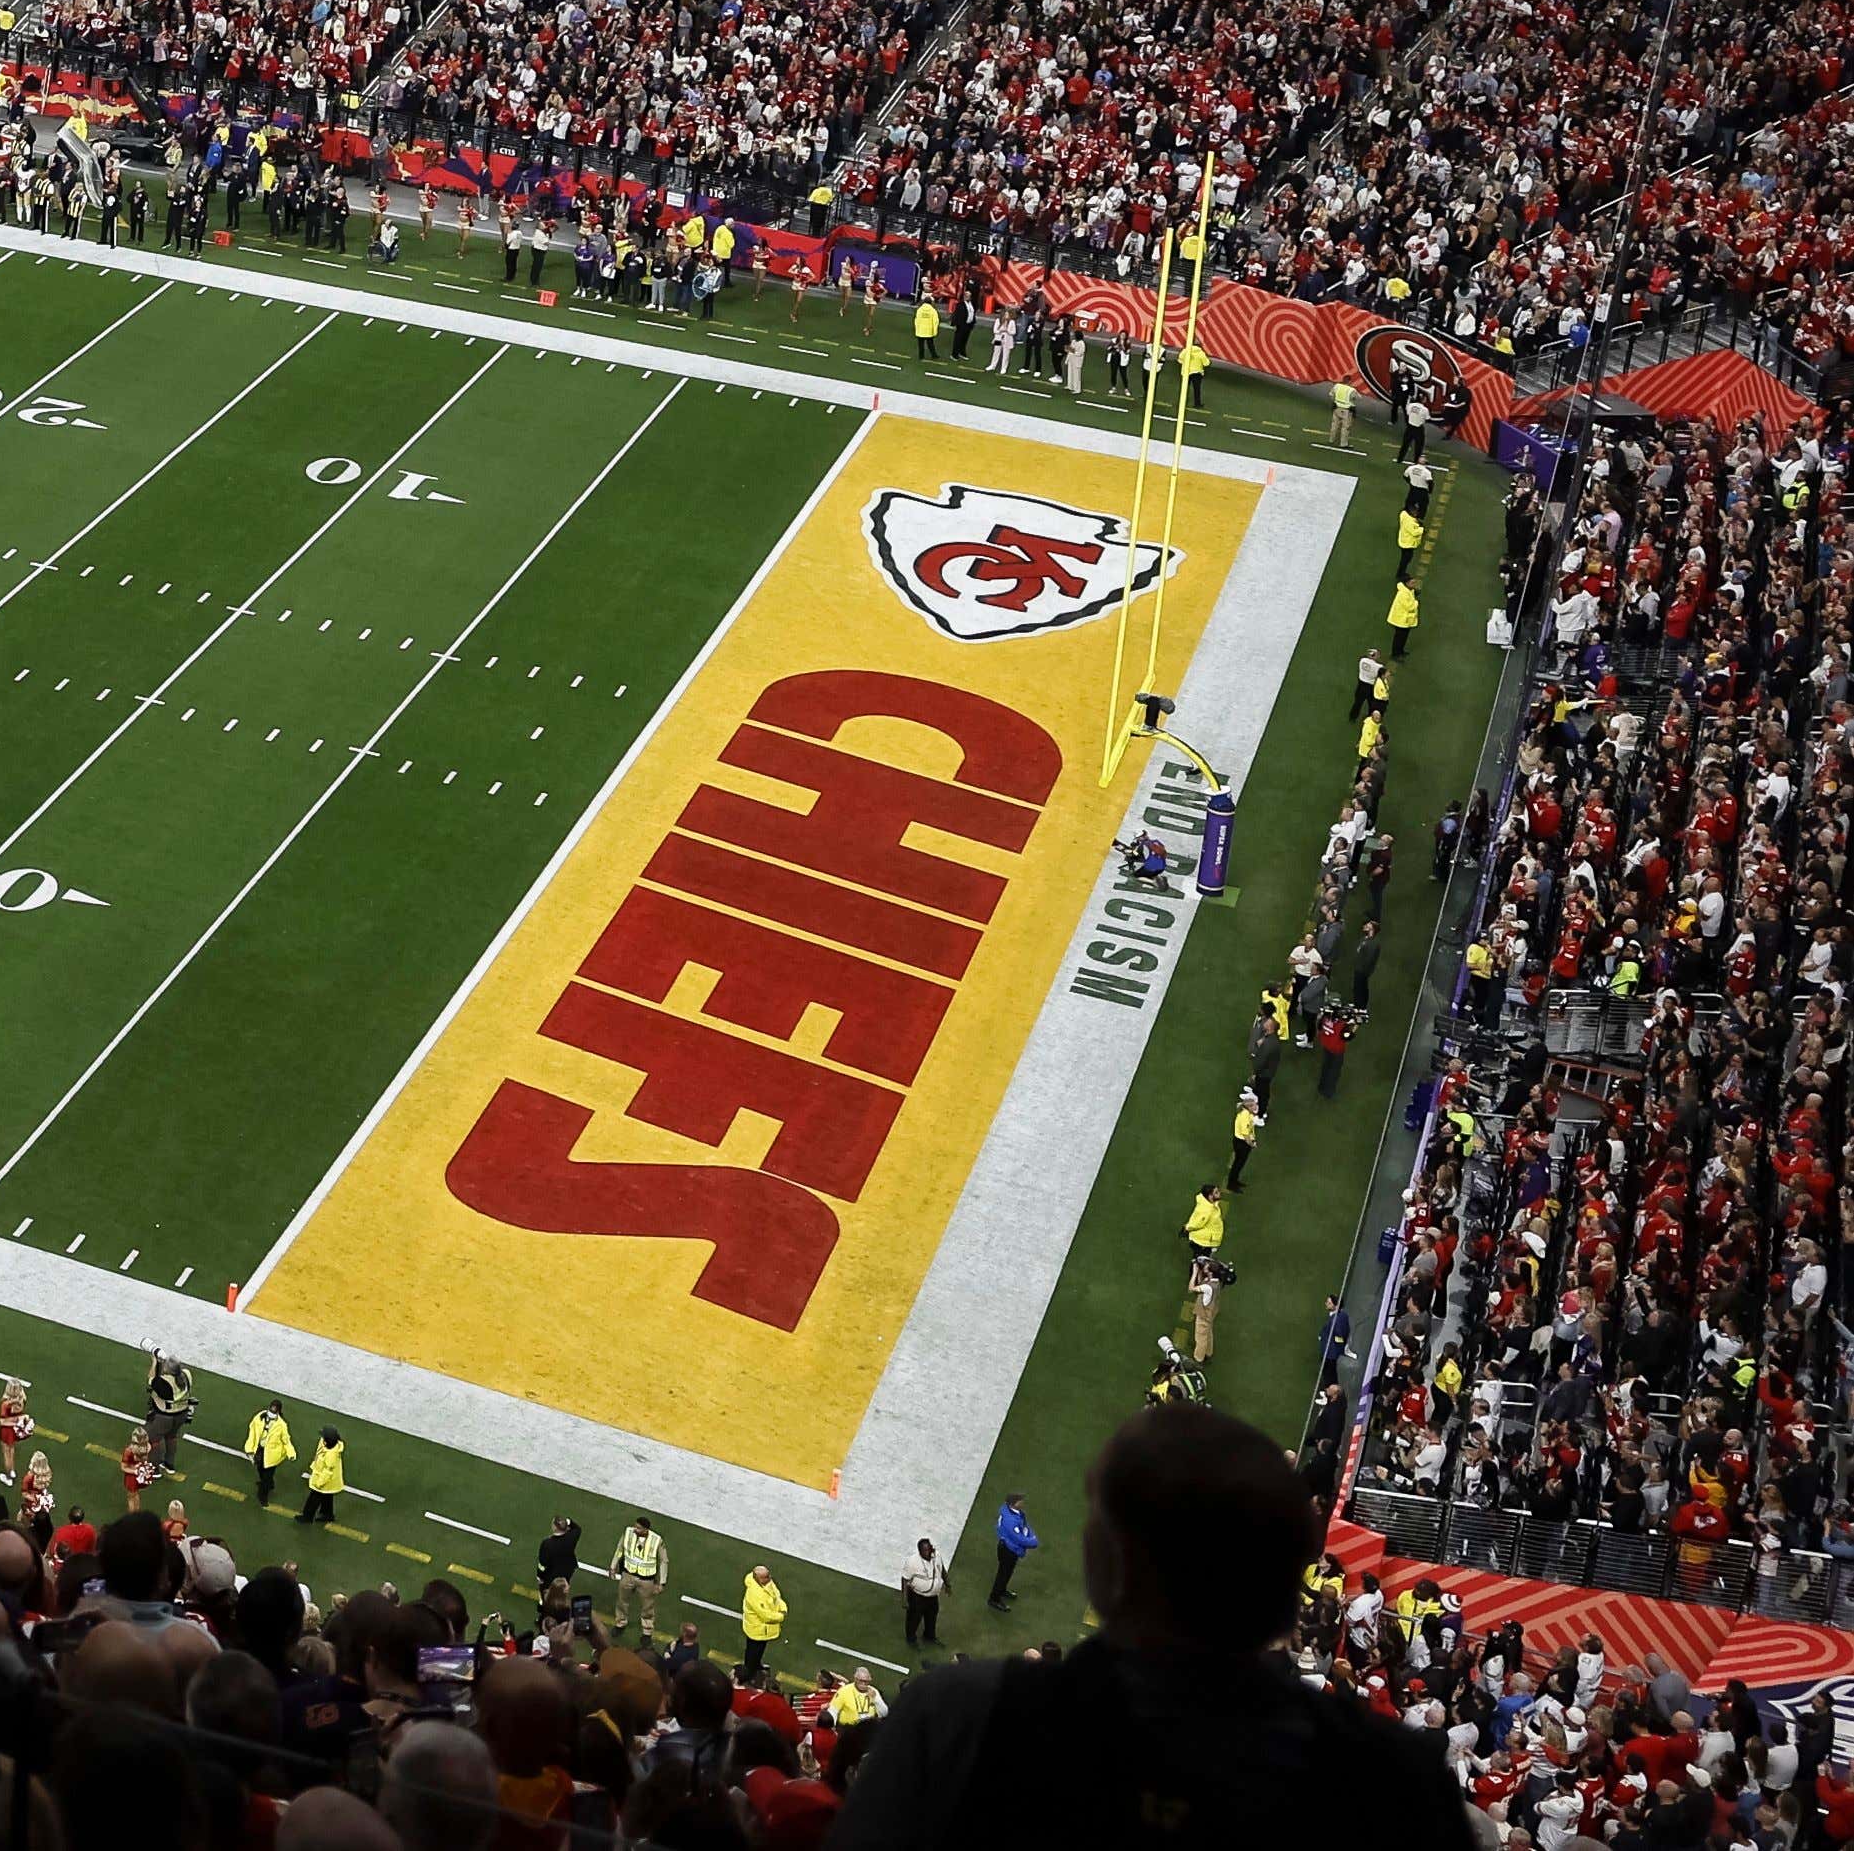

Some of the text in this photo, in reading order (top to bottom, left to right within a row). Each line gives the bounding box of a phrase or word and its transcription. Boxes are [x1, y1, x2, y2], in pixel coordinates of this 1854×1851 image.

[708, 190, 726, 201] 116
[977, 245, 996, 255] 117
[304, 457, 436, 500] 10
[1143, 760, 1230, 837] END
[445, 669, 1062, 1333] CHIEFS
